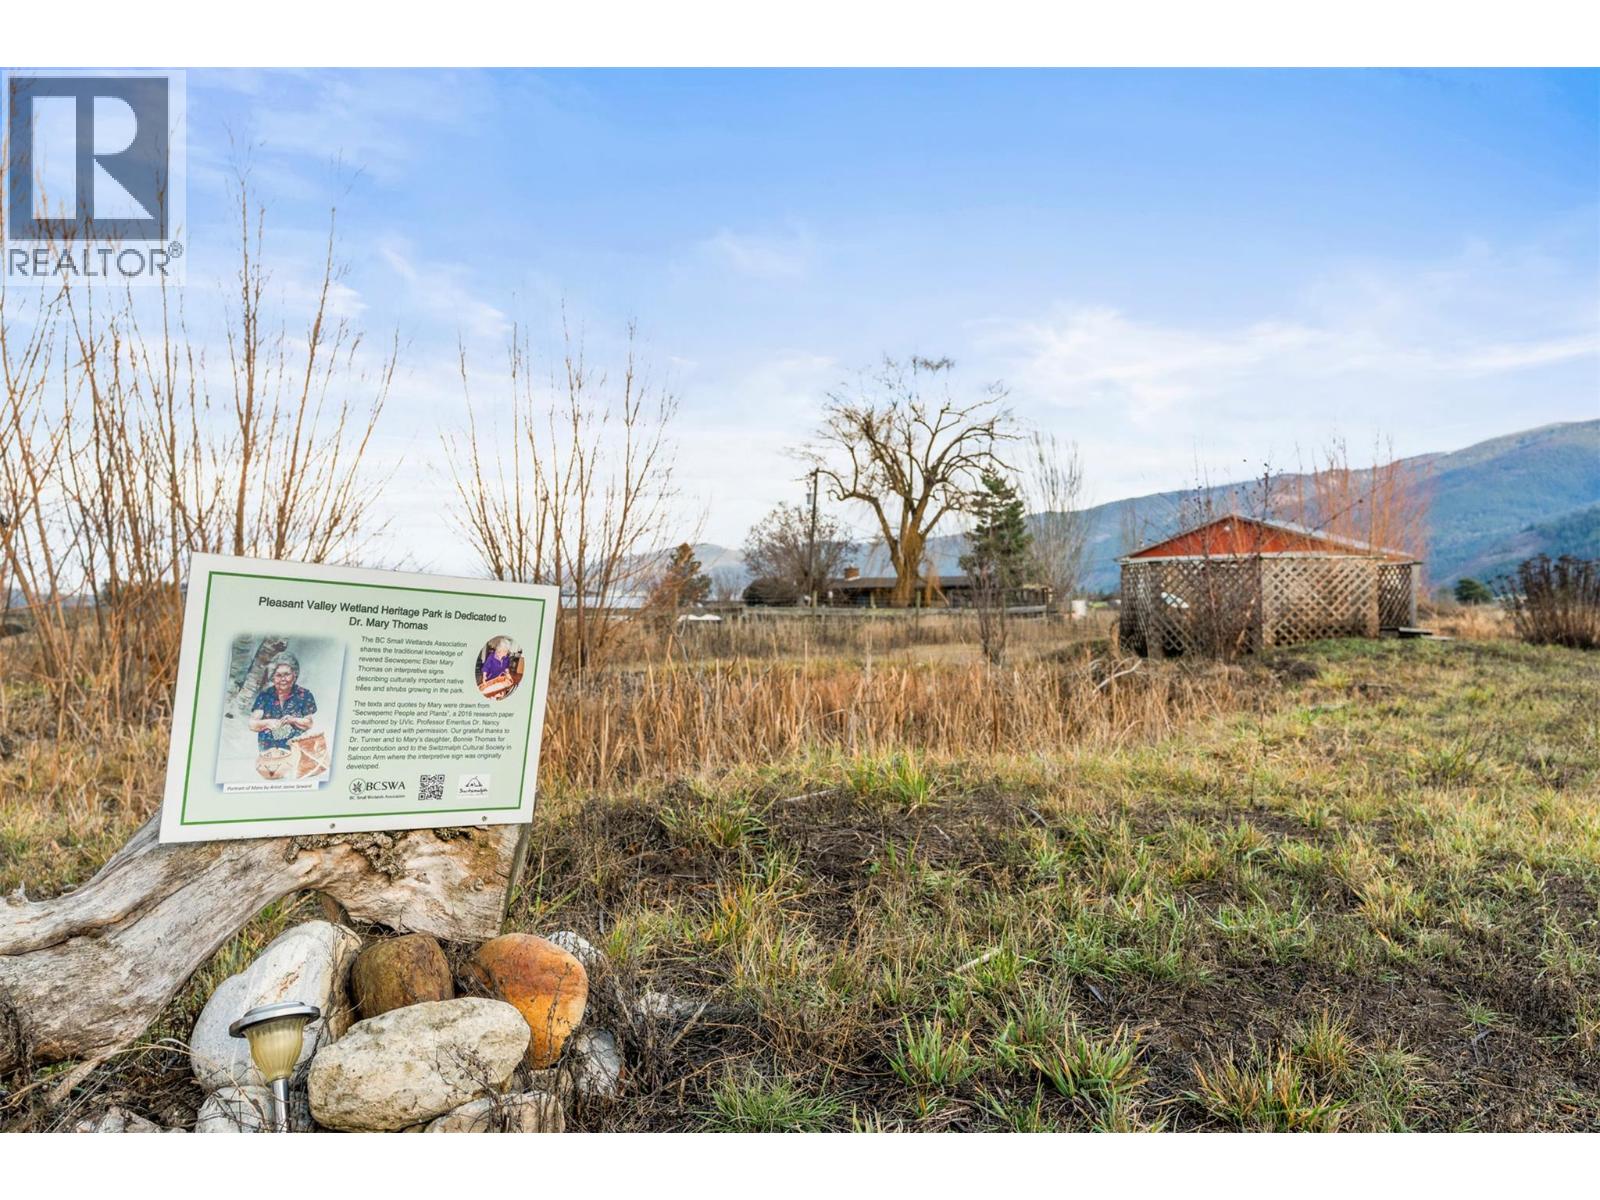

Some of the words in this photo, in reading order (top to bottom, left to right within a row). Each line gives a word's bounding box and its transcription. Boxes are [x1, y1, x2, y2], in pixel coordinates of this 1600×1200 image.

[259, 597, 304, 609] Pleasant
[306, 600, 337, 613] Valley
[340, 603, 379, 614] Wetland
[381, 605, 420, 618] Heritage
[422, 608, 442, 618] Park
[444, 610, 452, 619] is
[454, 610, 496, 622] Dedicated
[498, 614, 506, 623] to
[349, 617, 363, 626] Dr.
[366, 619, 390, 630] Mary
[392, 620, 428, 631] Thomas
[425, 649, 456, 657] knowledge
[439, 659, 454, 667] Mary
[366, 781, 406, 791] BCSWA
